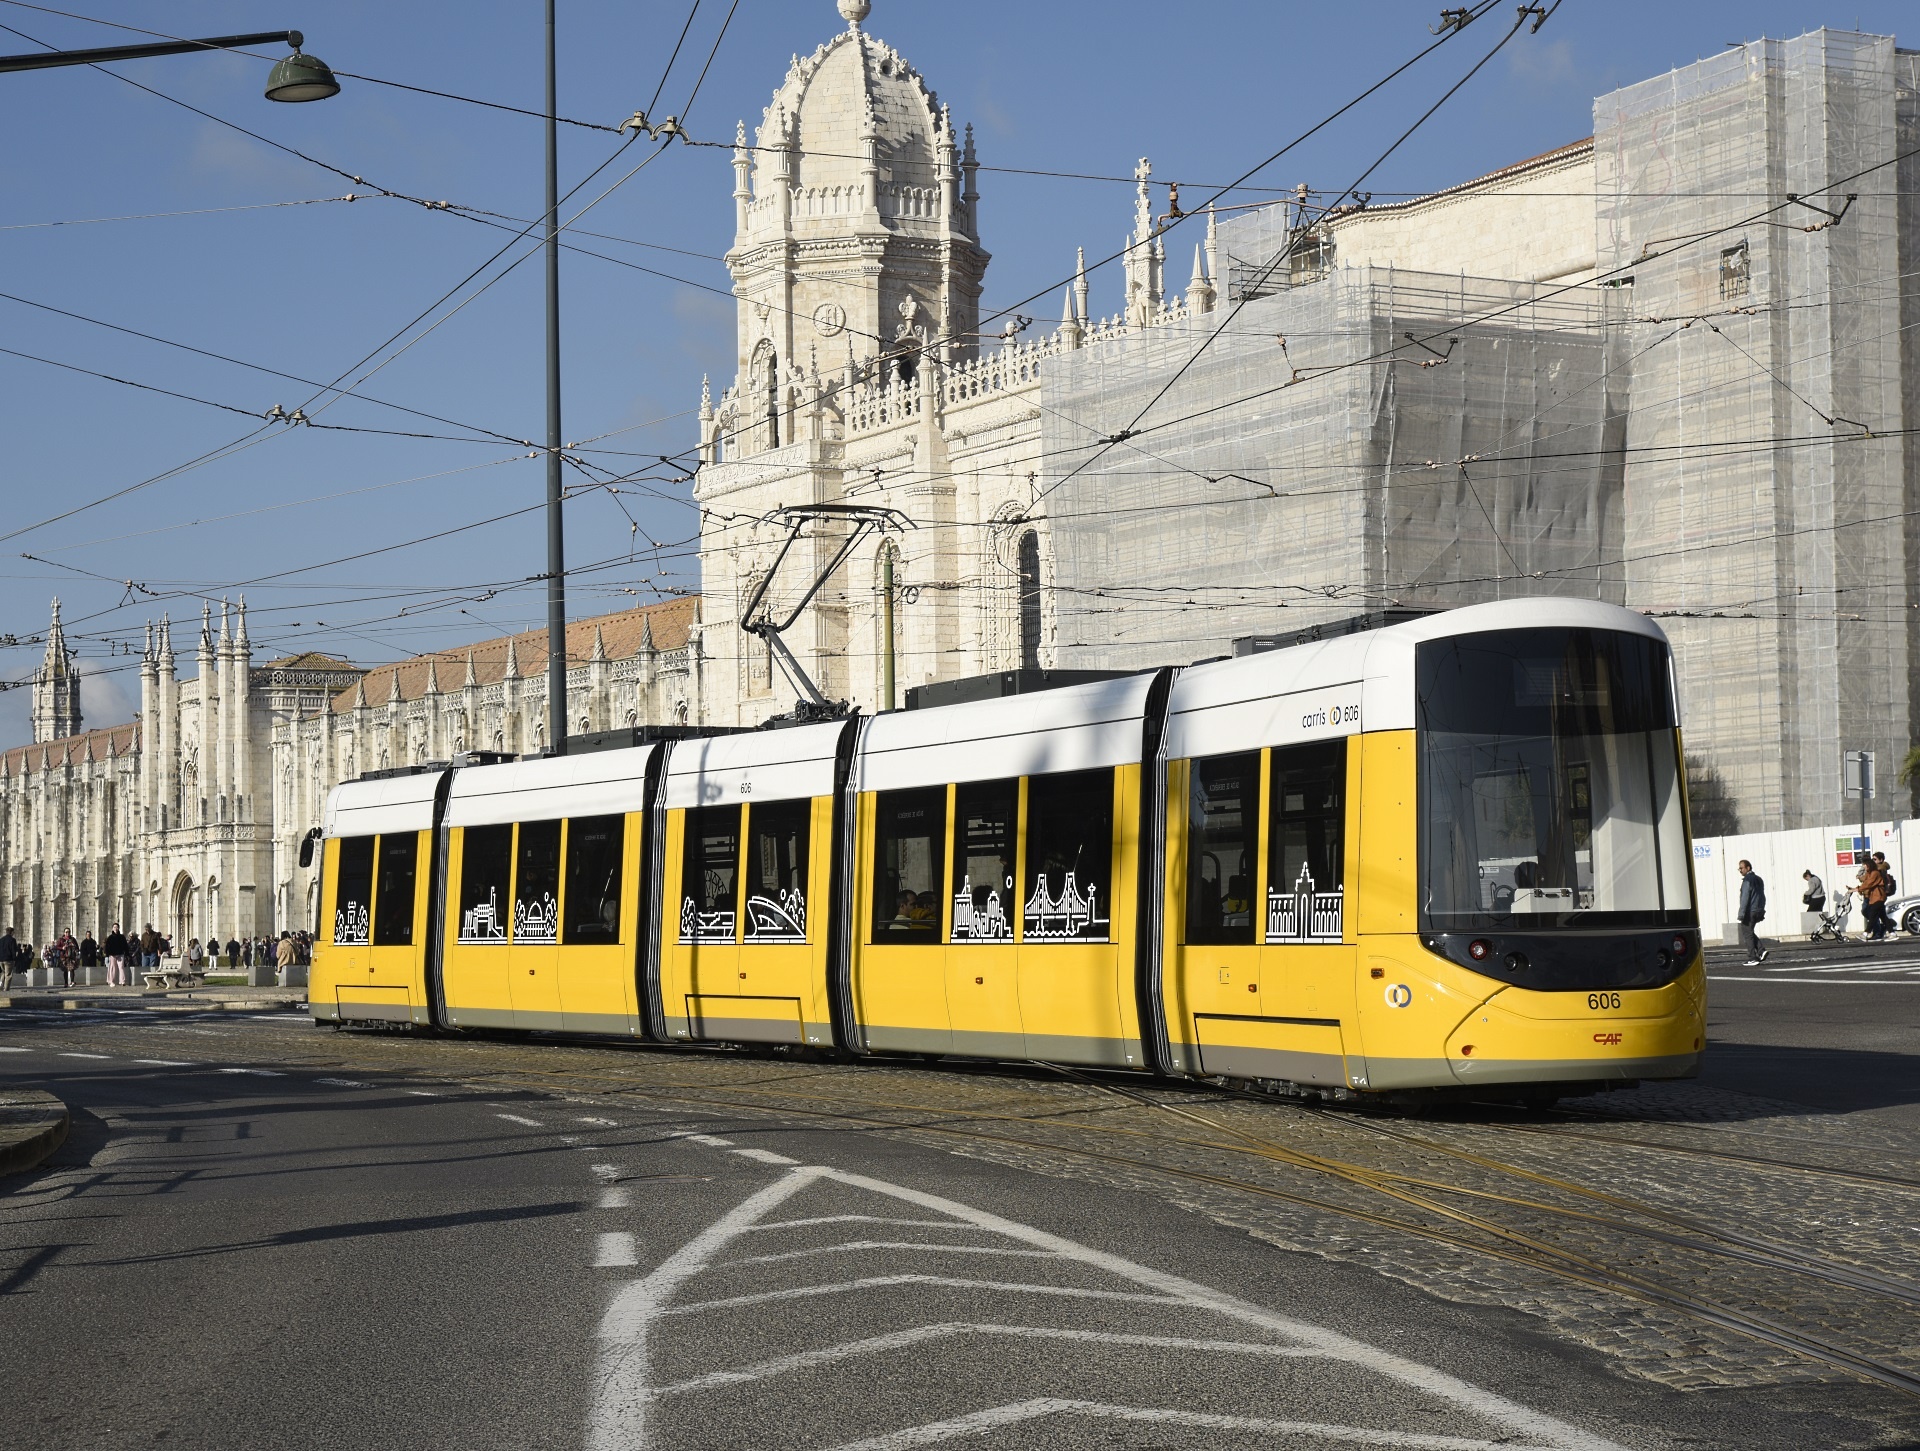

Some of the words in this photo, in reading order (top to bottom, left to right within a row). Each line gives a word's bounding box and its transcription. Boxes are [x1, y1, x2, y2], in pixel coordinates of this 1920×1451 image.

[1302, 707, 1326, 728] carris
[1344, 704, 1359, 722] 606
[740, 782, 752, 794] 606
[1588, 992, 1621, 1010] 606
[1593, 1033, 1622, 1045] CAF
